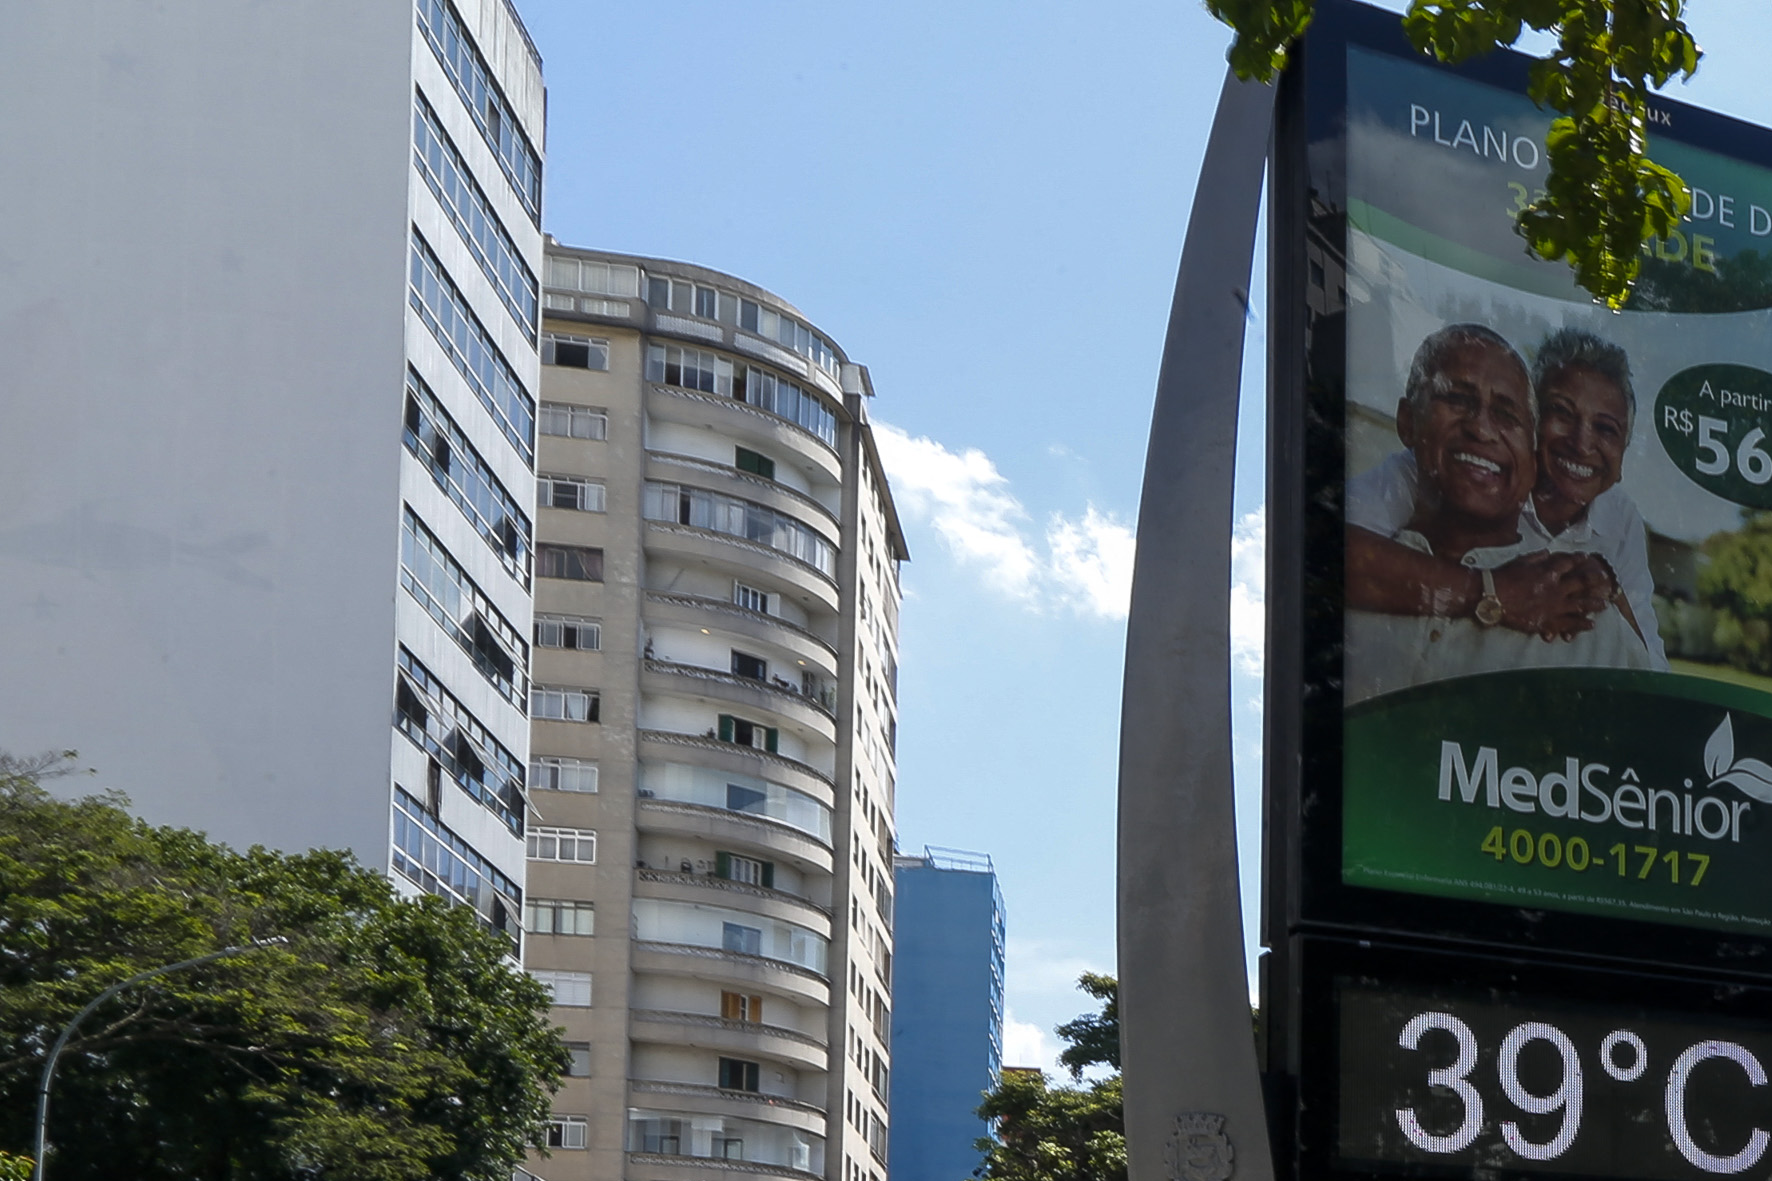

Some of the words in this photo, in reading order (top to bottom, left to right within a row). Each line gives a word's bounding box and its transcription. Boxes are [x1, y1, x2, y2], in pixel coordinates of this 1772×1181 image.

[1409, 102, 1539, 171] PLANO
[1699, 379, 1715, 401] A
[1720, 388, 1772, 413] partir
[1437, 739, 1752, 843] MedSênior
[1480, 825, 1711, 887] 4000-1717
[1395, 1010, 1770, 1174] 39°C
